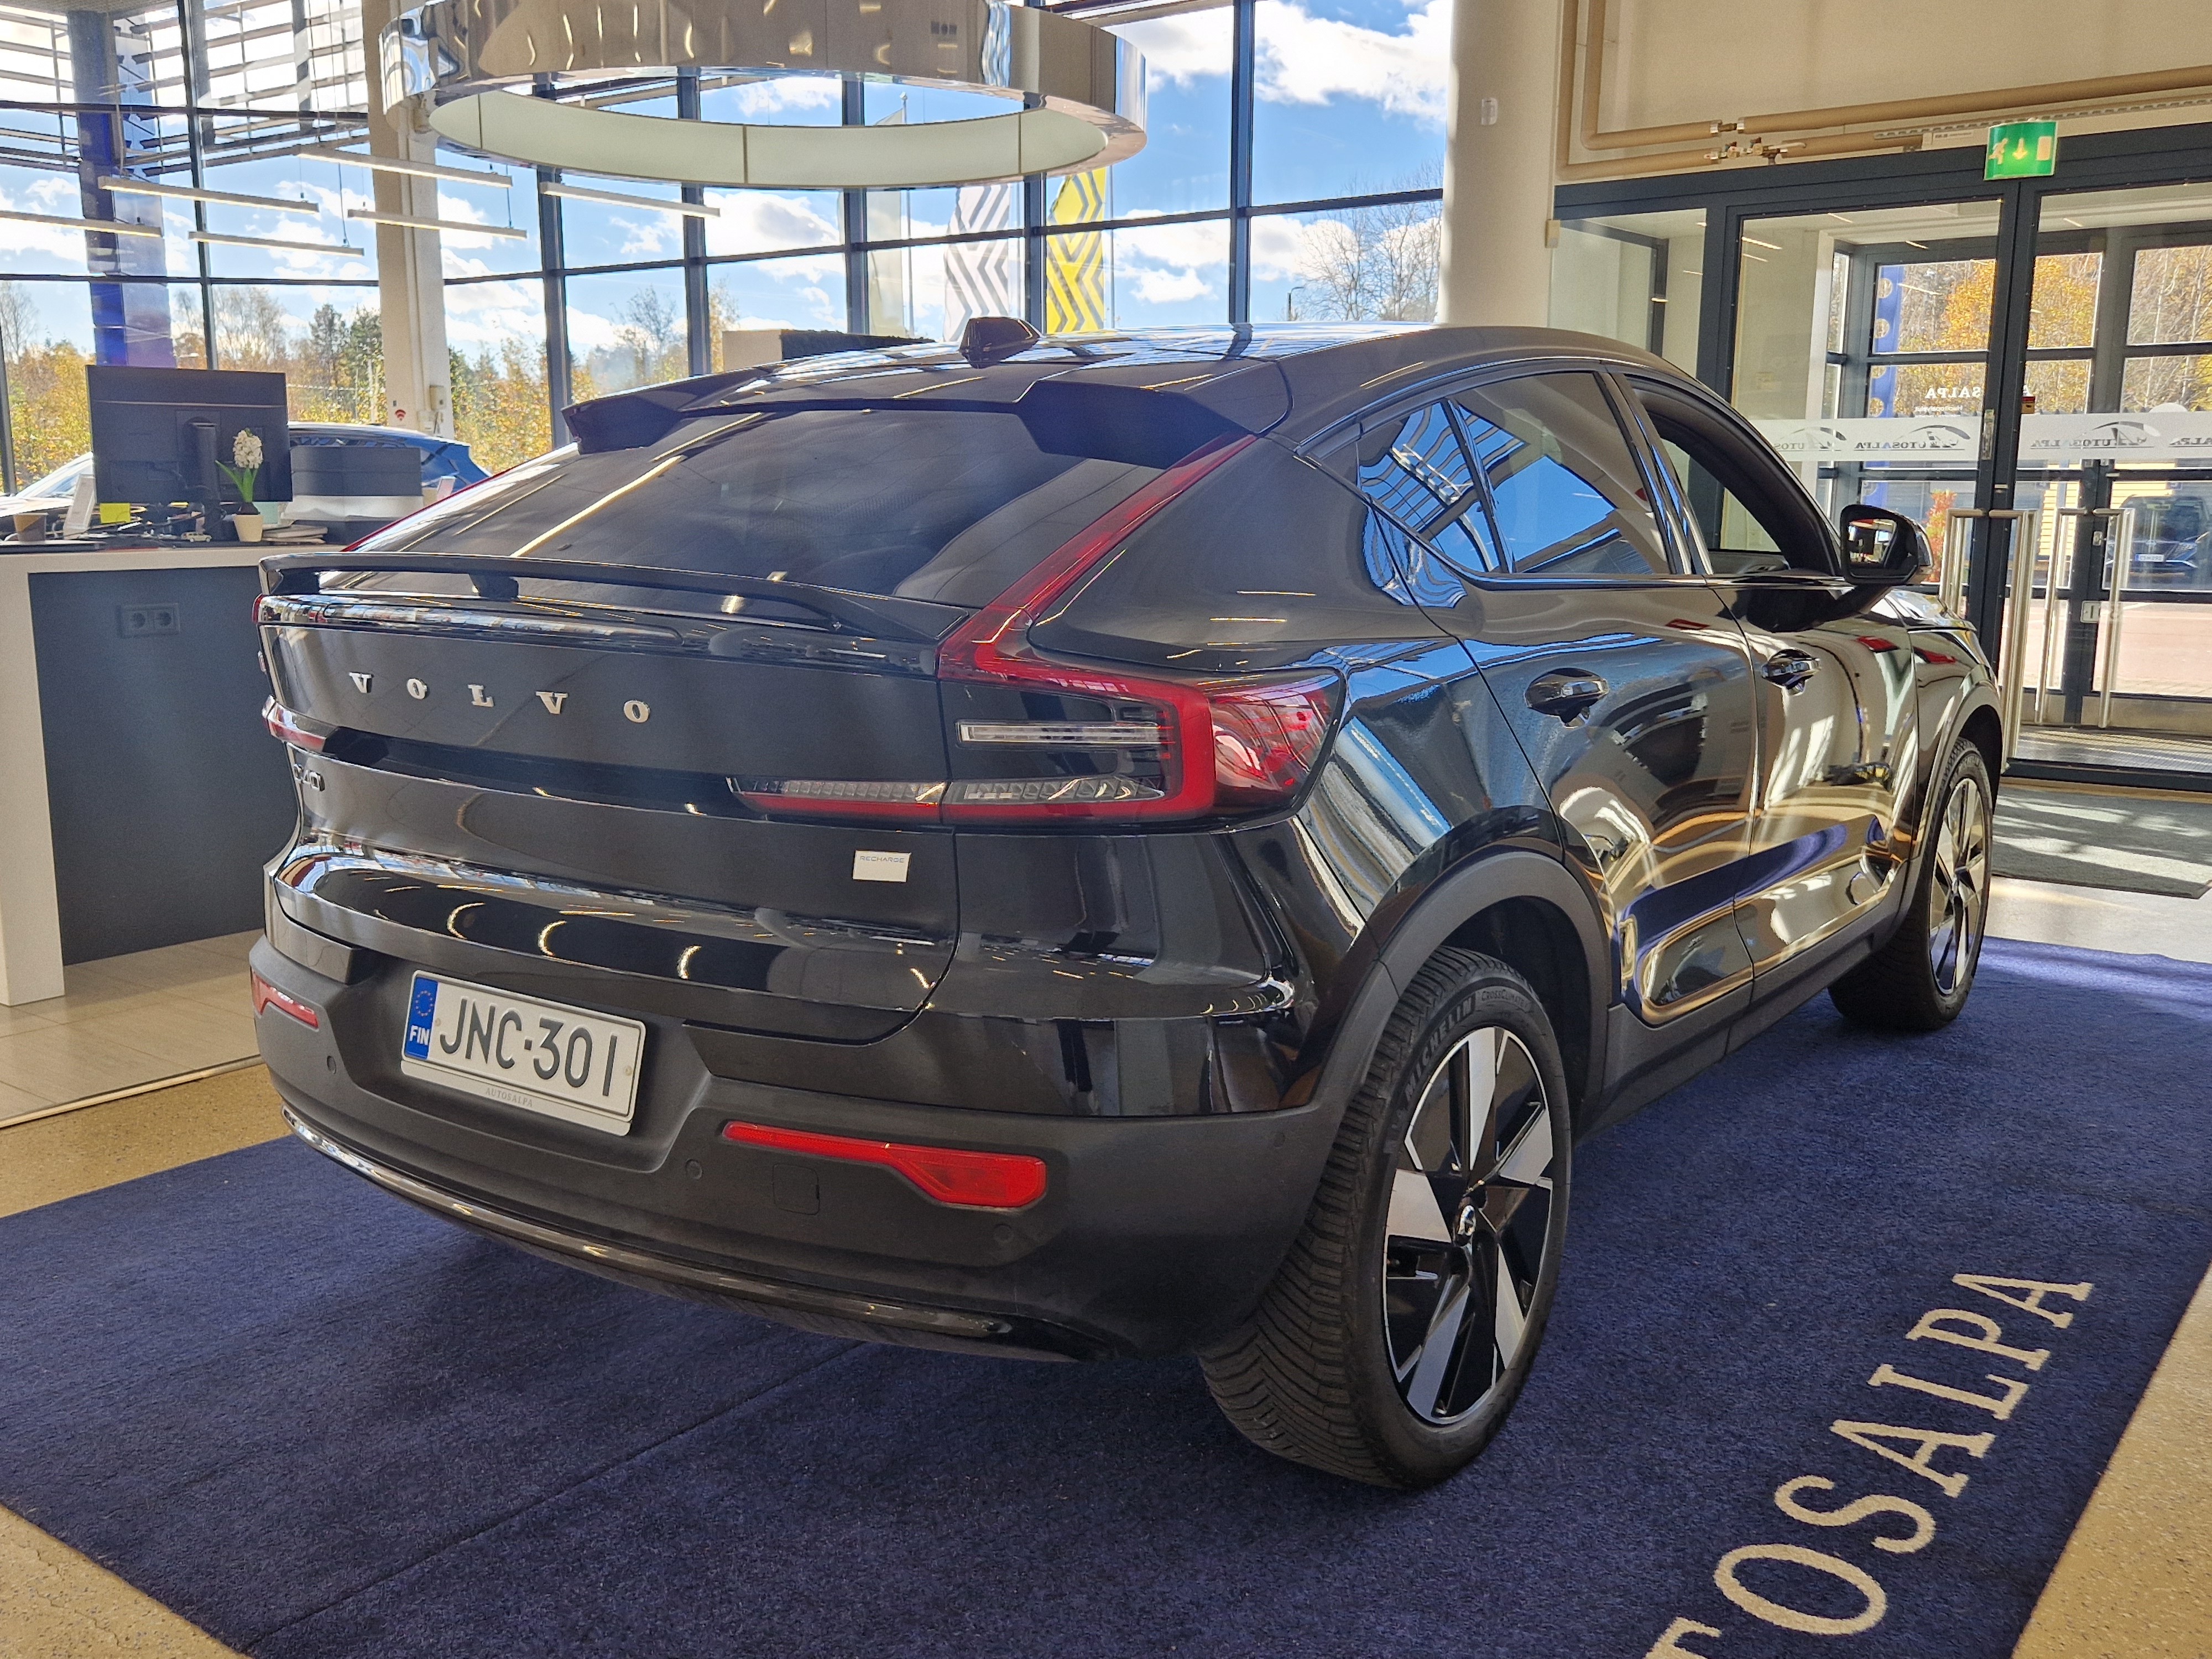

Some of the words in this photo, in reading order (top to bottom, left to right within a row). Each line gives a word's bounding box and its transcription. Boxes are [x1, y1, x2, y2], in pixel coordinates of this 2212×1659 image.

[349, 672, 651, 723] VOLVO
[408, 1024, 431, 1046] FIN
[1405, 996, 1473, 1103] MICHELIN
[486, 1087, 533, 1108] AUTOSALPA
